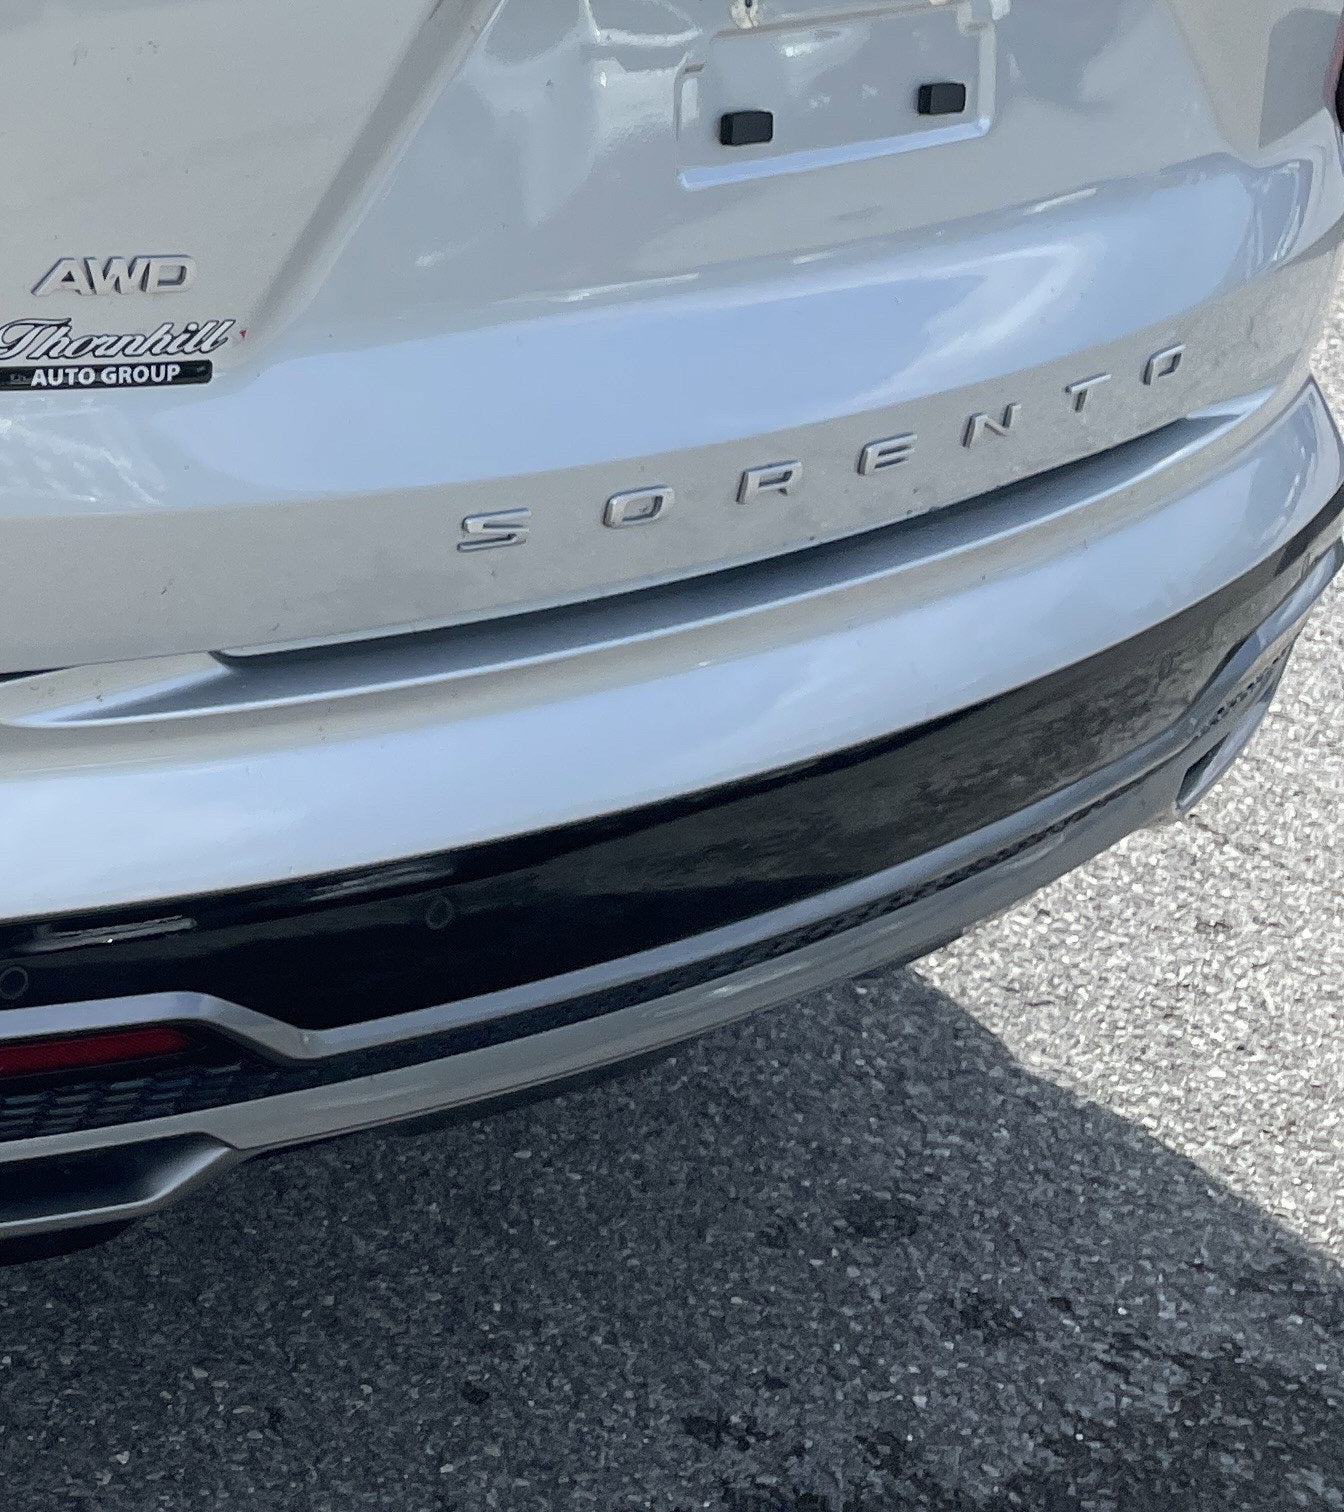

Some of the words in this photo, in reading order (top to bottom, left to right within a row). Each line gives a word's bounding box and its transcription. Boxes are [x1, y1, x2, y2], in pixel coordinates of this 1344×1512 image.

[31, 254, 198, 297] AWD
[30, 366, 97, 387] AUTO
[100, 364, 181, 385] GROUP
[457, 343, 1187, 553] SORENTO
